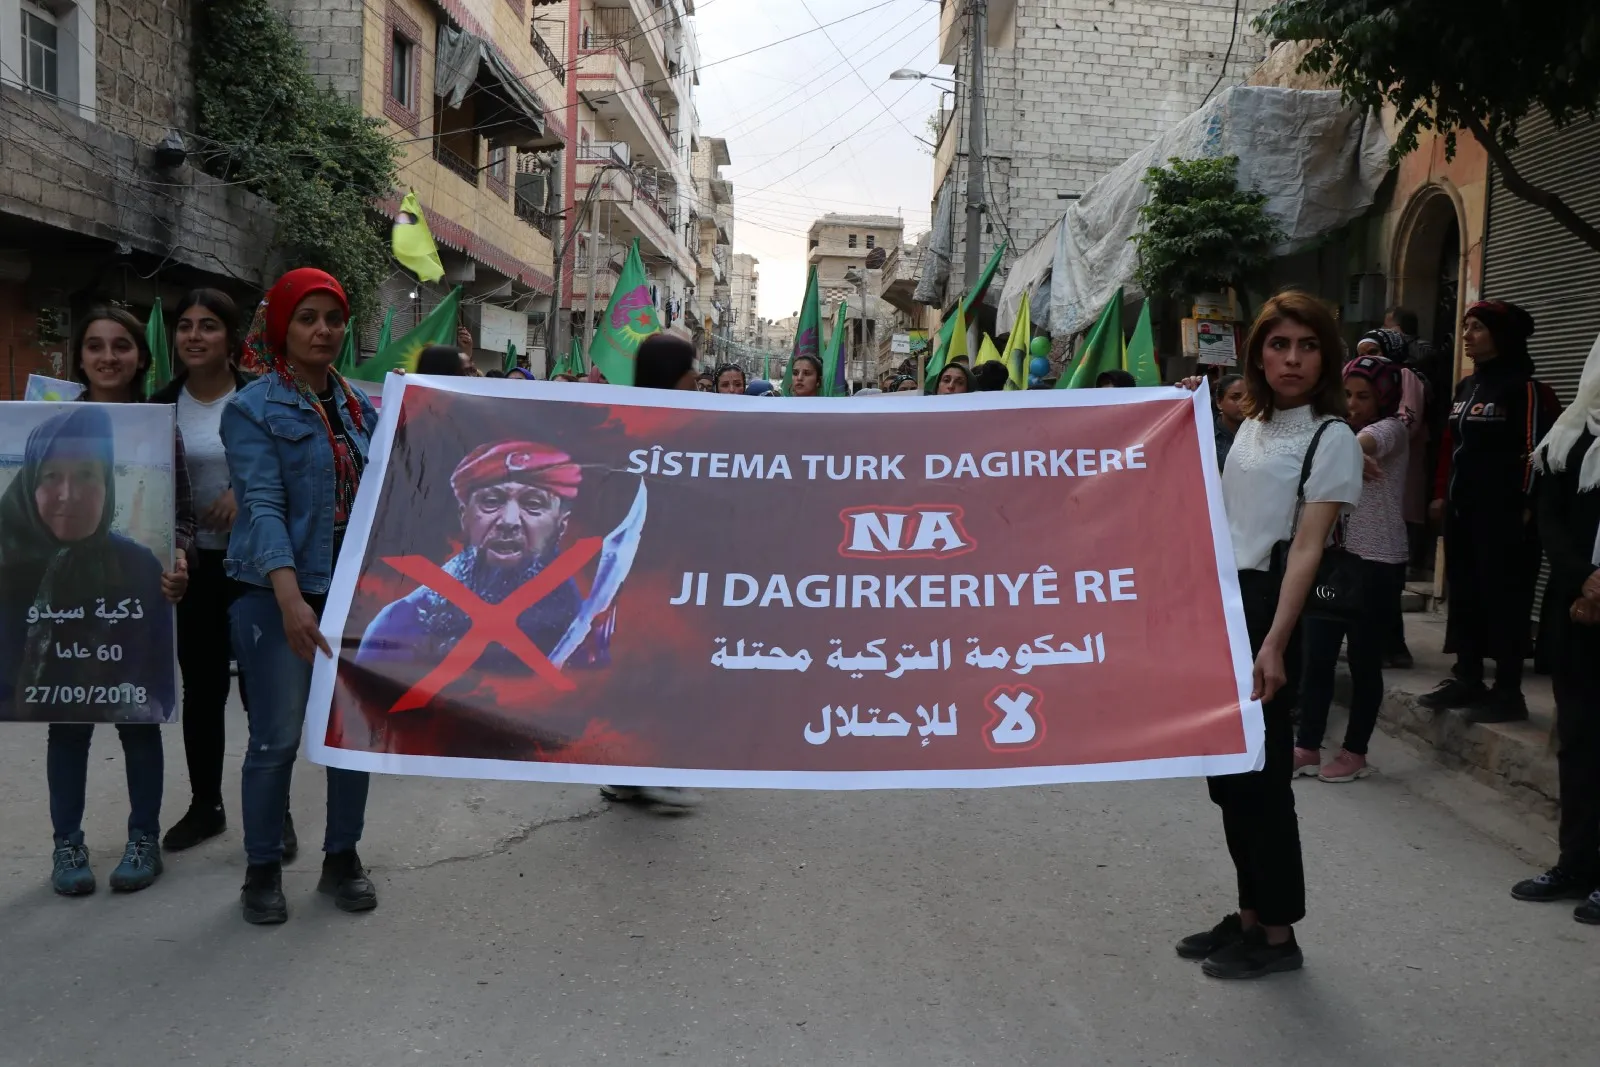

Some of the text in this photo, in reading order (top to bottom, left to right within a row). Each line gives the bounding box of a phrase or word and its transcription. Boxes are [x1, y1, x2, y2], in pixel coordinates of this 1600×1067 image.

[627, 444, 1147, 481] SÎSTEMA TURK DAGIRKERE
[848, 512, 967, 552] NA
[670, 565, 1138, 608] JI DAGIRKERIYÊ RE
[26, 598, 144, 624] ذكية سيدو
[56, 642, 123, 661] 60 عاما
[710, 632, 1106, 679] الحكومة التركية محتلة
[25, 685, 147, 705] 27/09/2018
[803, 692, 1036, 747] لا للإحتلال
